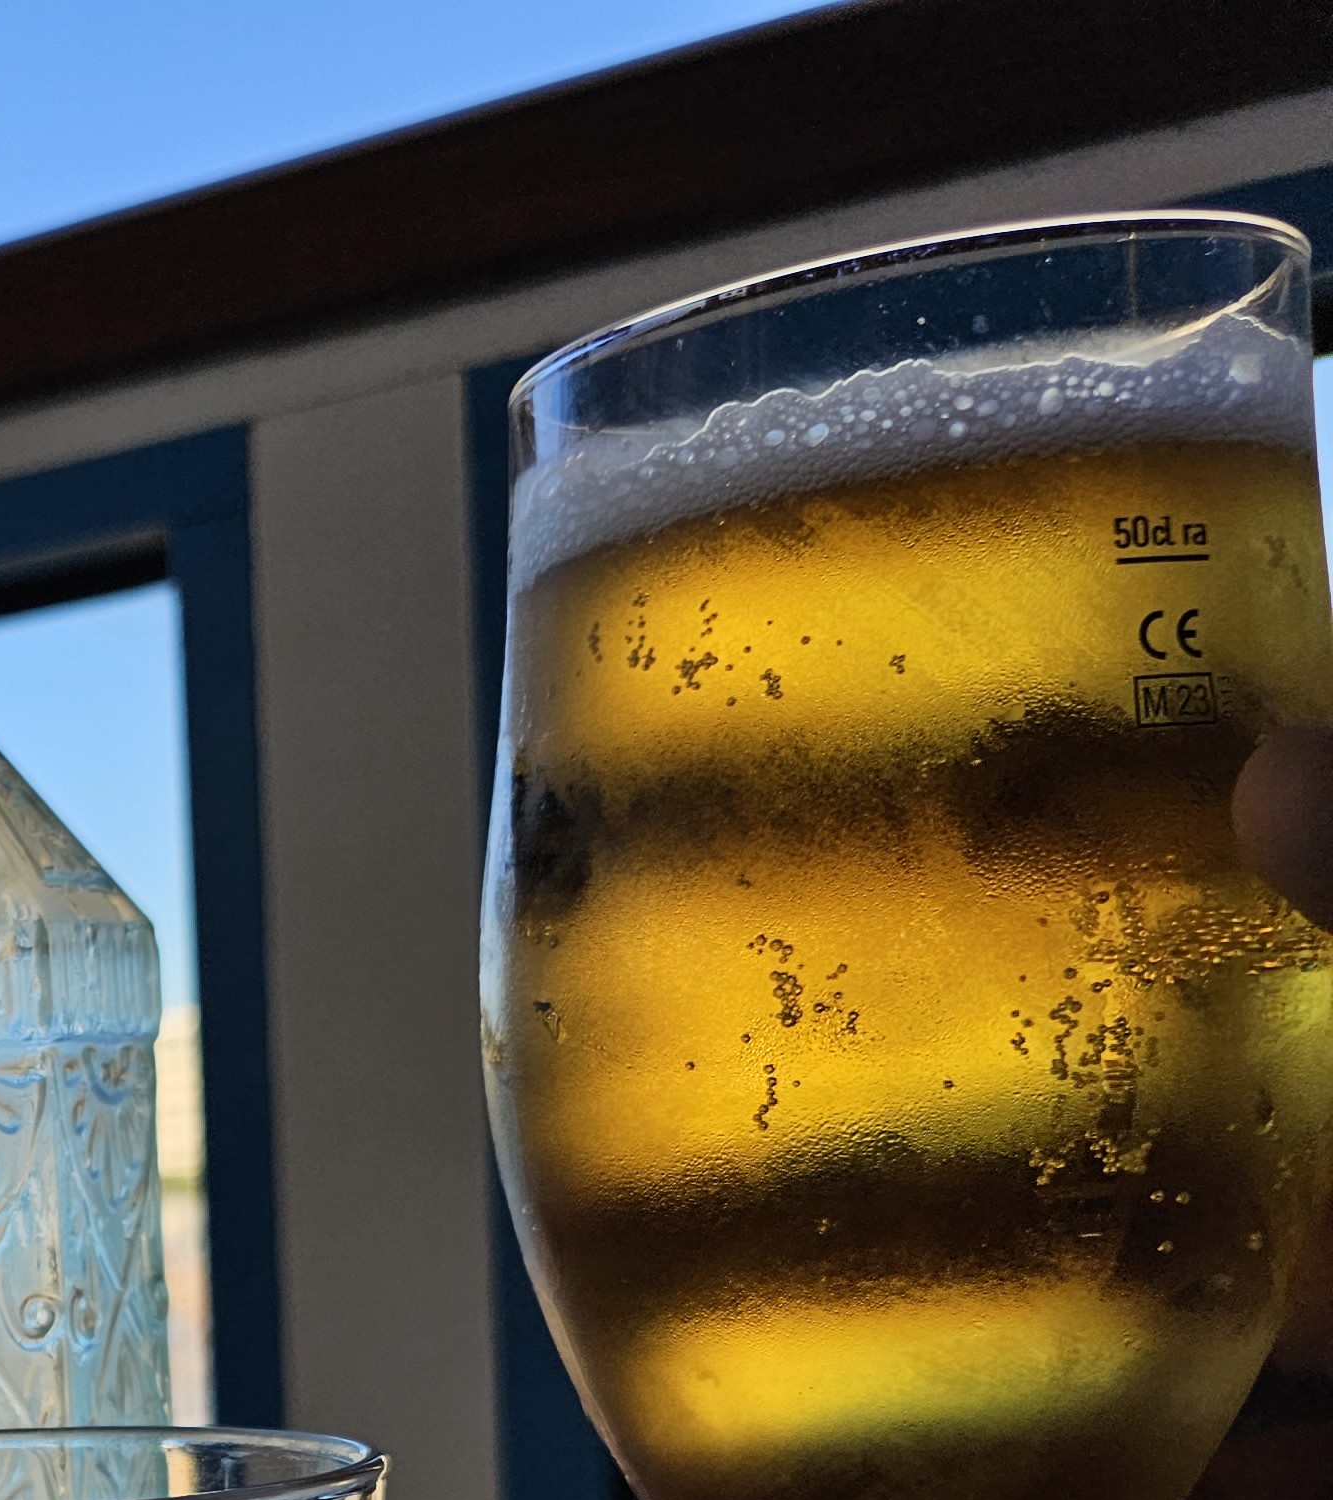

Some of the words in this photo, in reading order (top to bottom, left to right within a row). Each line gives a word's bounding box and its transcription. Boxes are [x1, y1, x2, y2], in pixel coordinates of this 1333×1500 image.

[1113, 515, 1175, 549] 50cl
[1181, 522, 1208, 546] ra
[1142, 686, 1169, 719] M
[1176, 683, 1210, 718] 23
